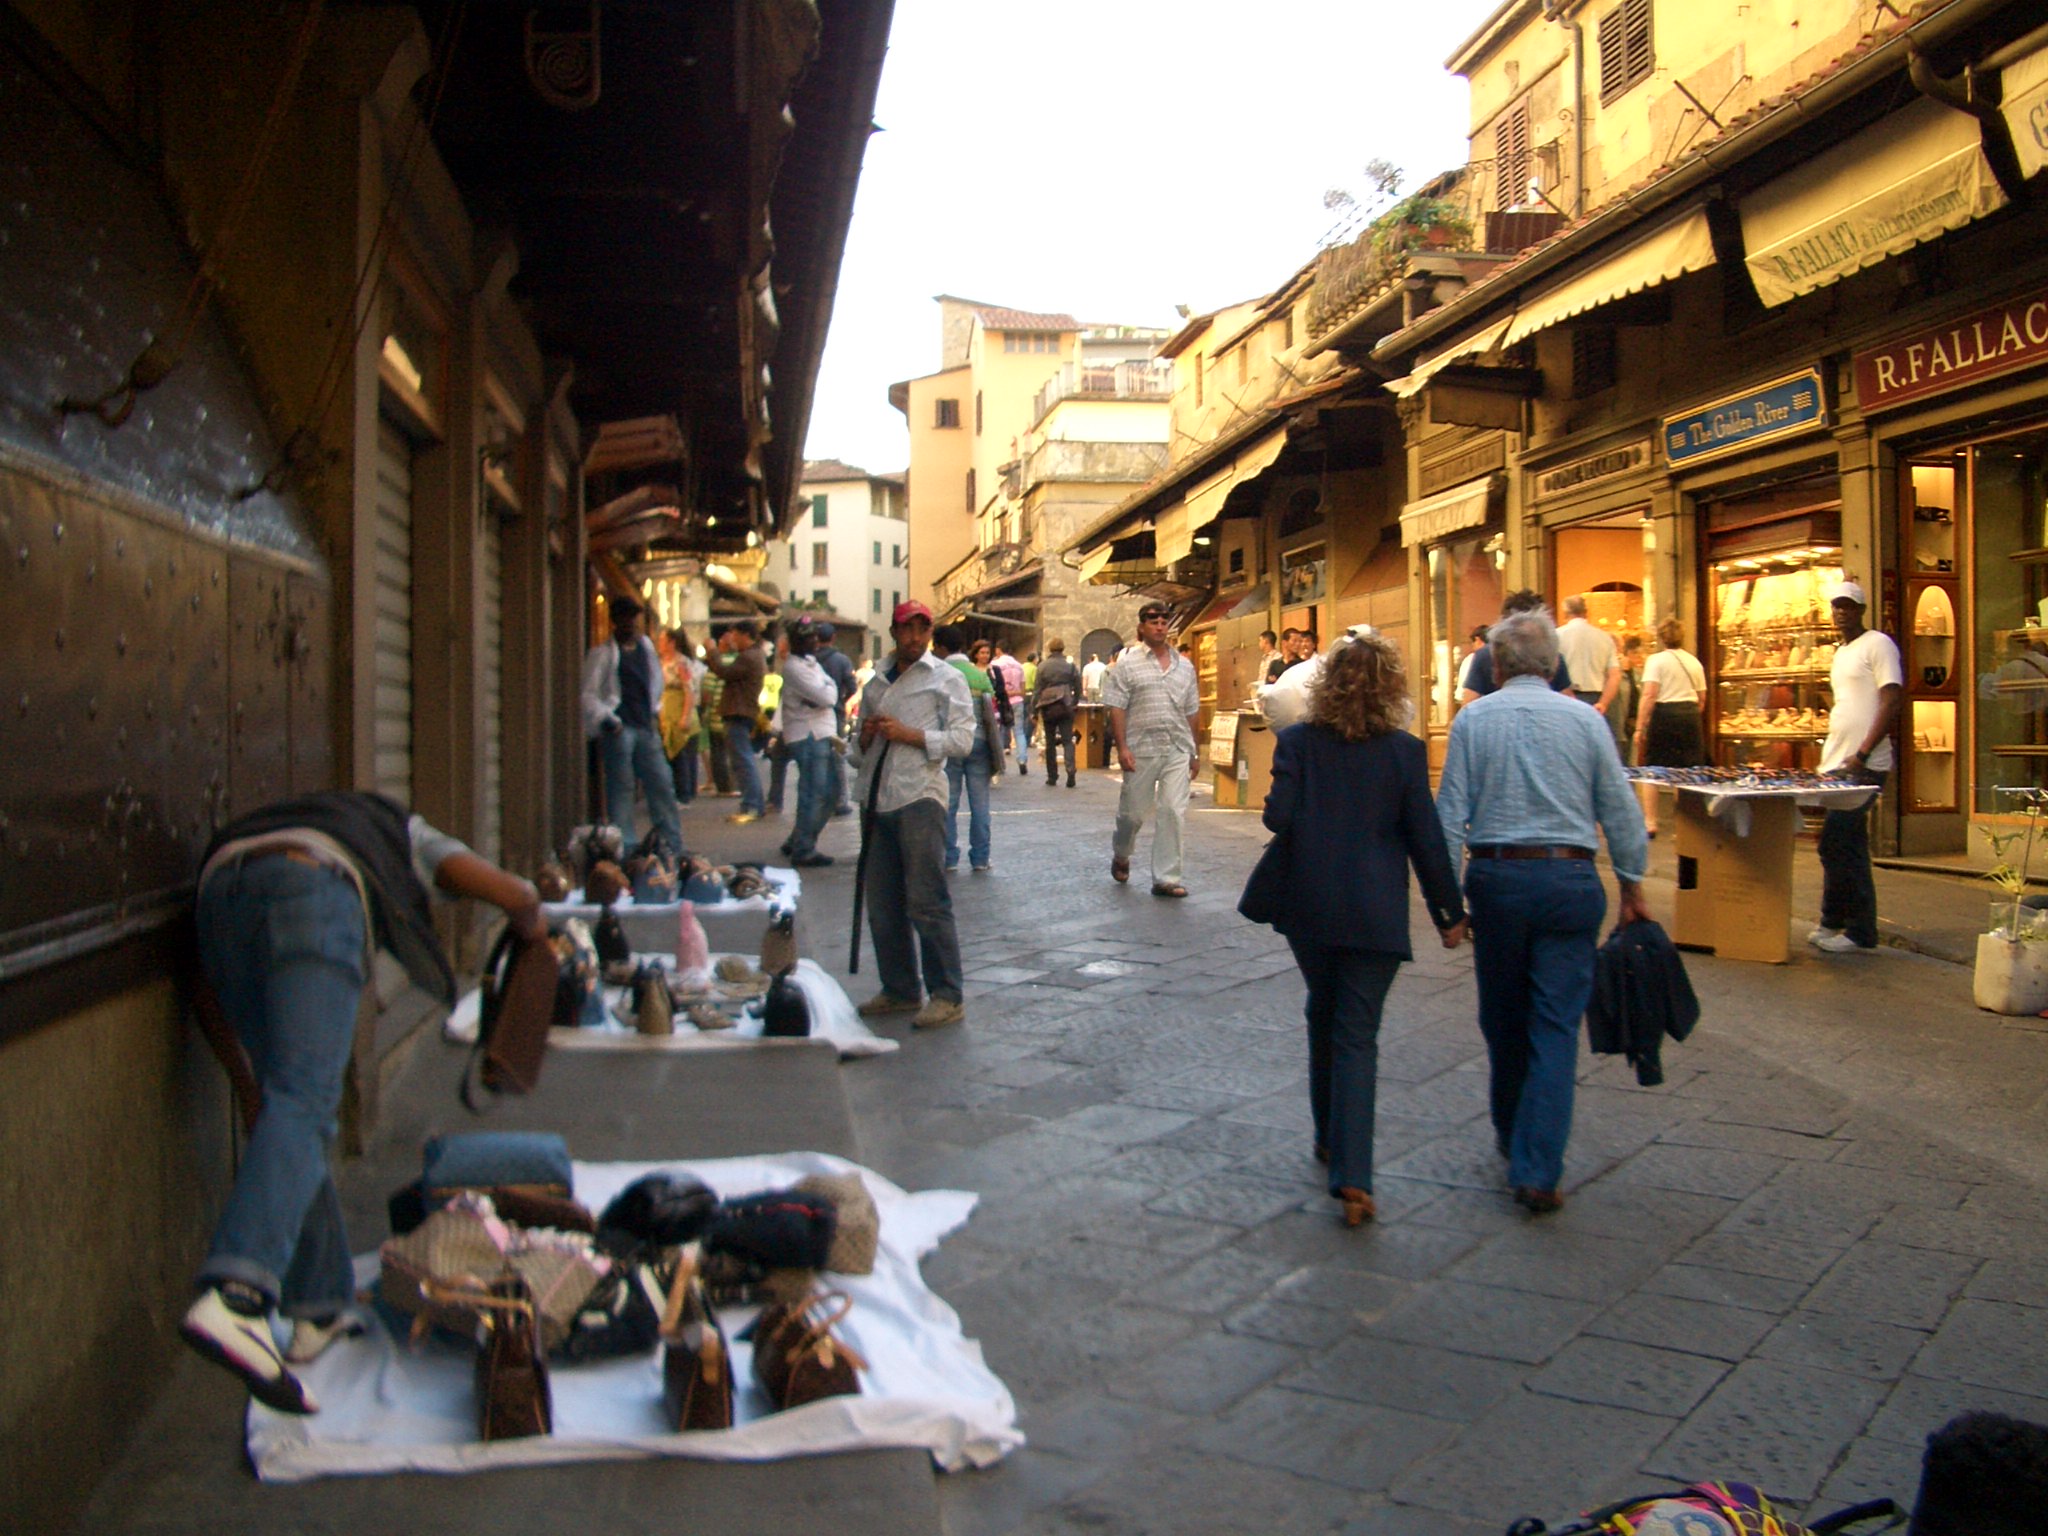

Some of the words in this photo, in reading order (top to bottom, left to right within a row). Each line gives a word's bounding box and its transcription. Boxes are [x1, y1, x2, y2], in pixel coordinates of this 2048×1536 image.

[1789, 221, 1860, 276] FALLACI
[1688, 421, 1713, 447] The
[1714, 408, 1755, 440] Golden
[1754, 400, 1791, 427] River
